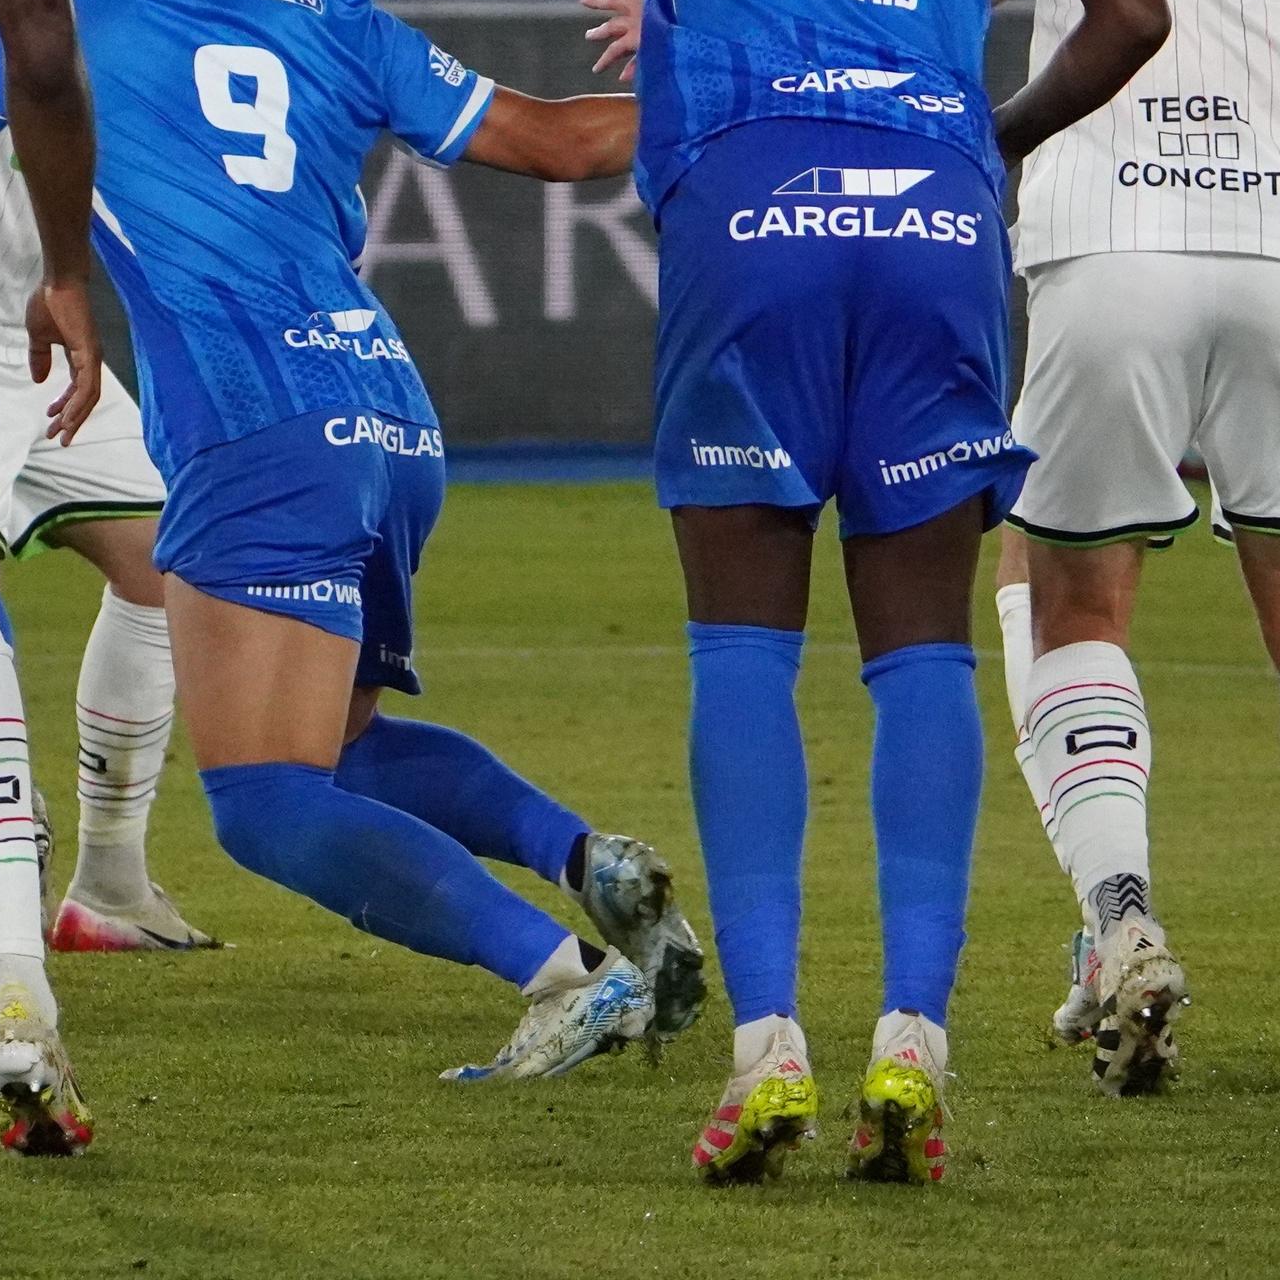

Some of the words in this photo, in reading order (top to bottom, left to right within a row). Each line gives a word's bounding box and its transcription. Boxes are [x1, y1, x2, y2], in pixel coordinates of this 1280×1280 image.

[194, 44, 297, 192] 9
[1138, 96, 1249, 125] TEGEL
[729, 206, 977, 245] CARGLASS
[284, 329, 409, 362] CARLASS
